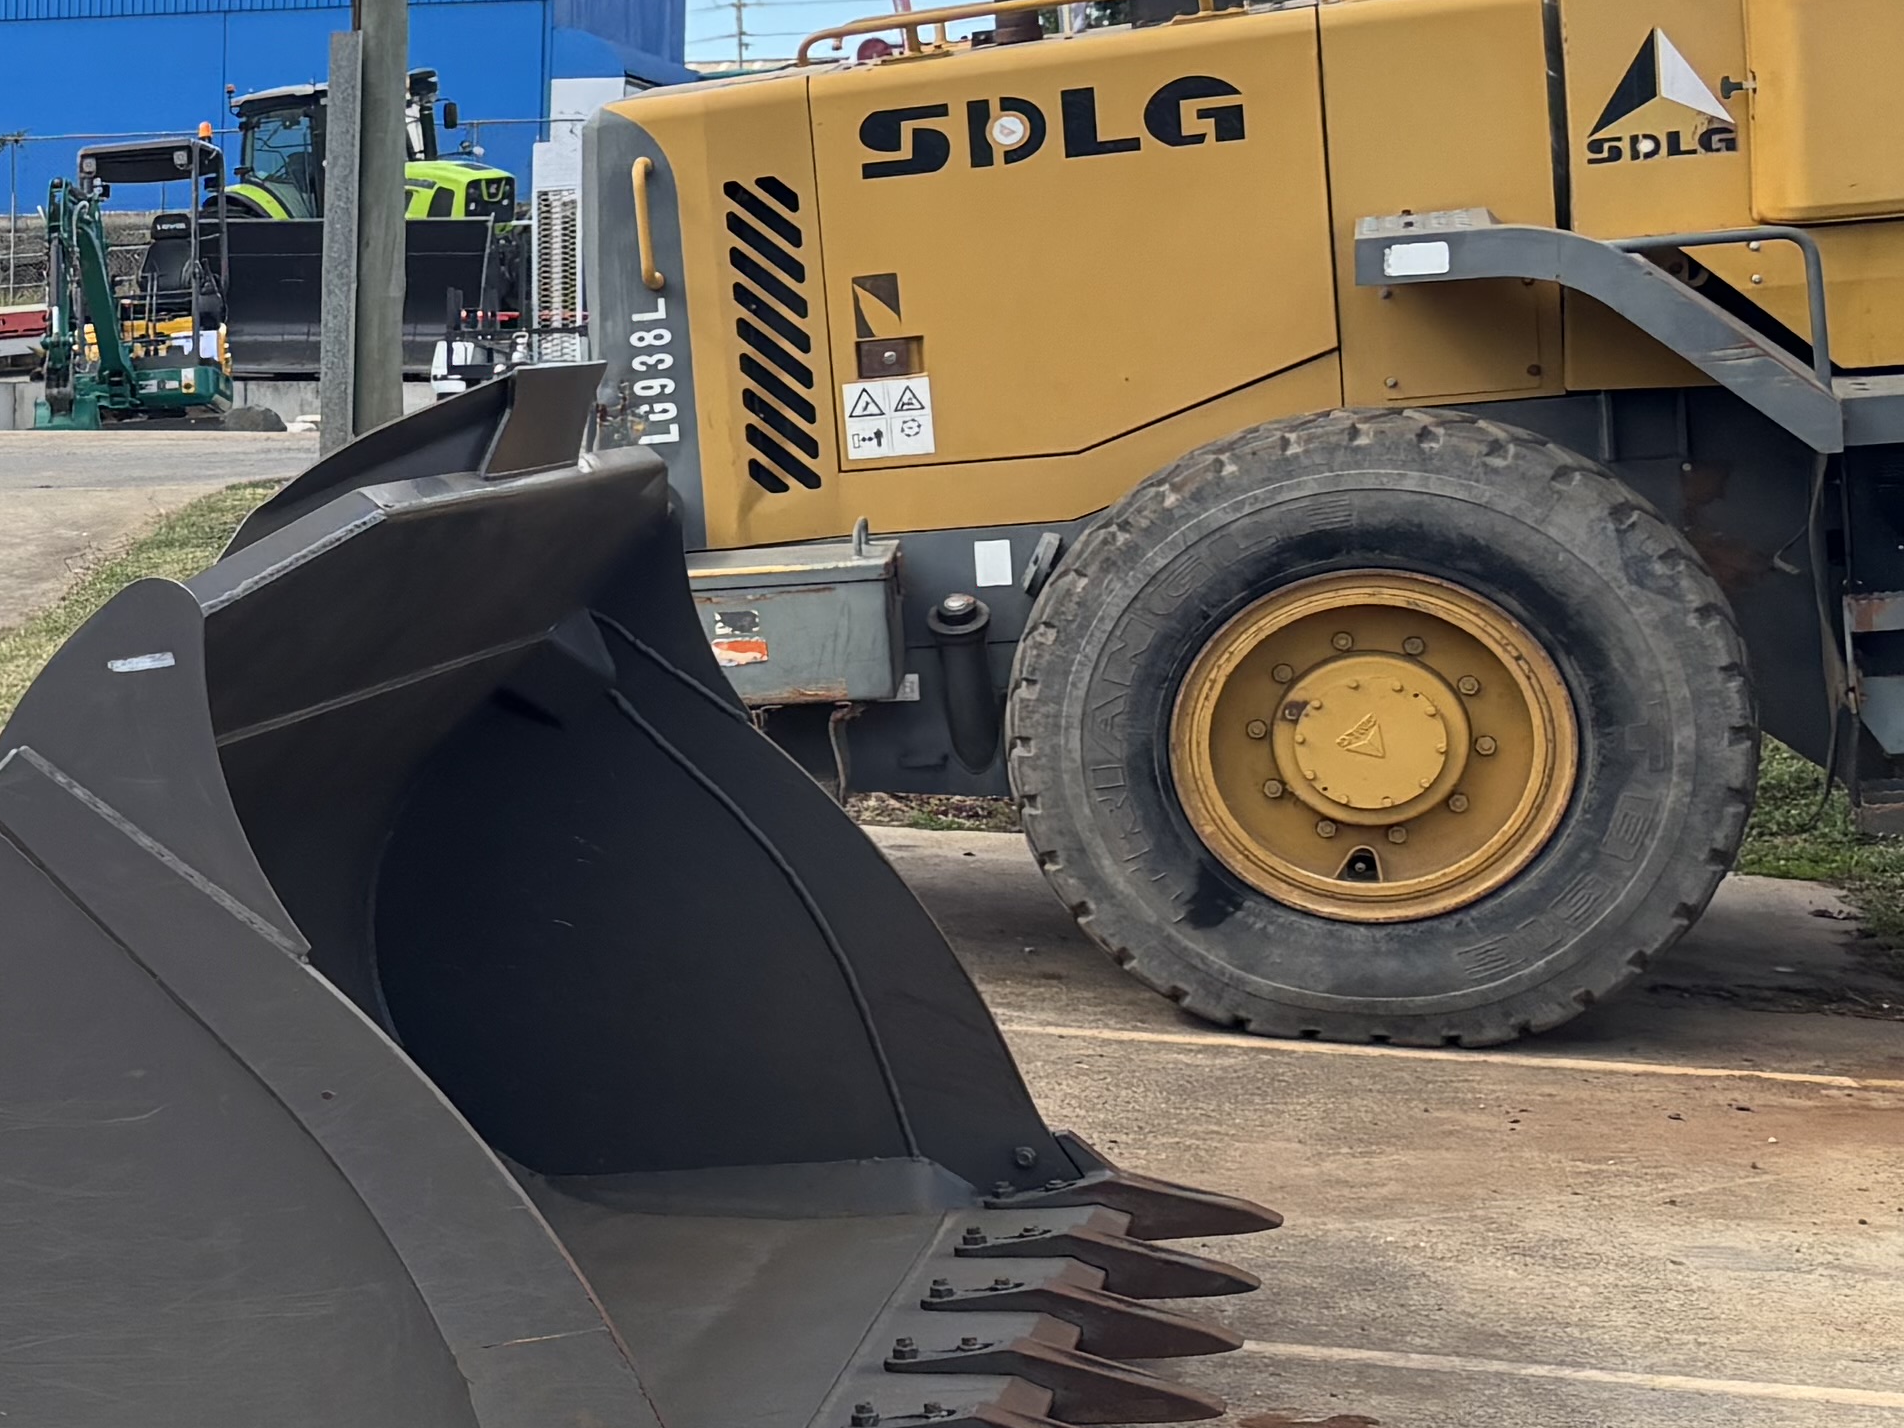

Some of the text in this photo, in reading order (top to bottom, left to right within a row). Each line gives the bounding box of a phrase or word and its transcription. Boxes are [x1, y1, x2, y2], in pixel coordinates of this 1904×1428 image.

[859, 75, 1245, 180] SDLG
[1587, 127, 1737, 165] SDLG
[629, 298, 680, 445] LG938L
